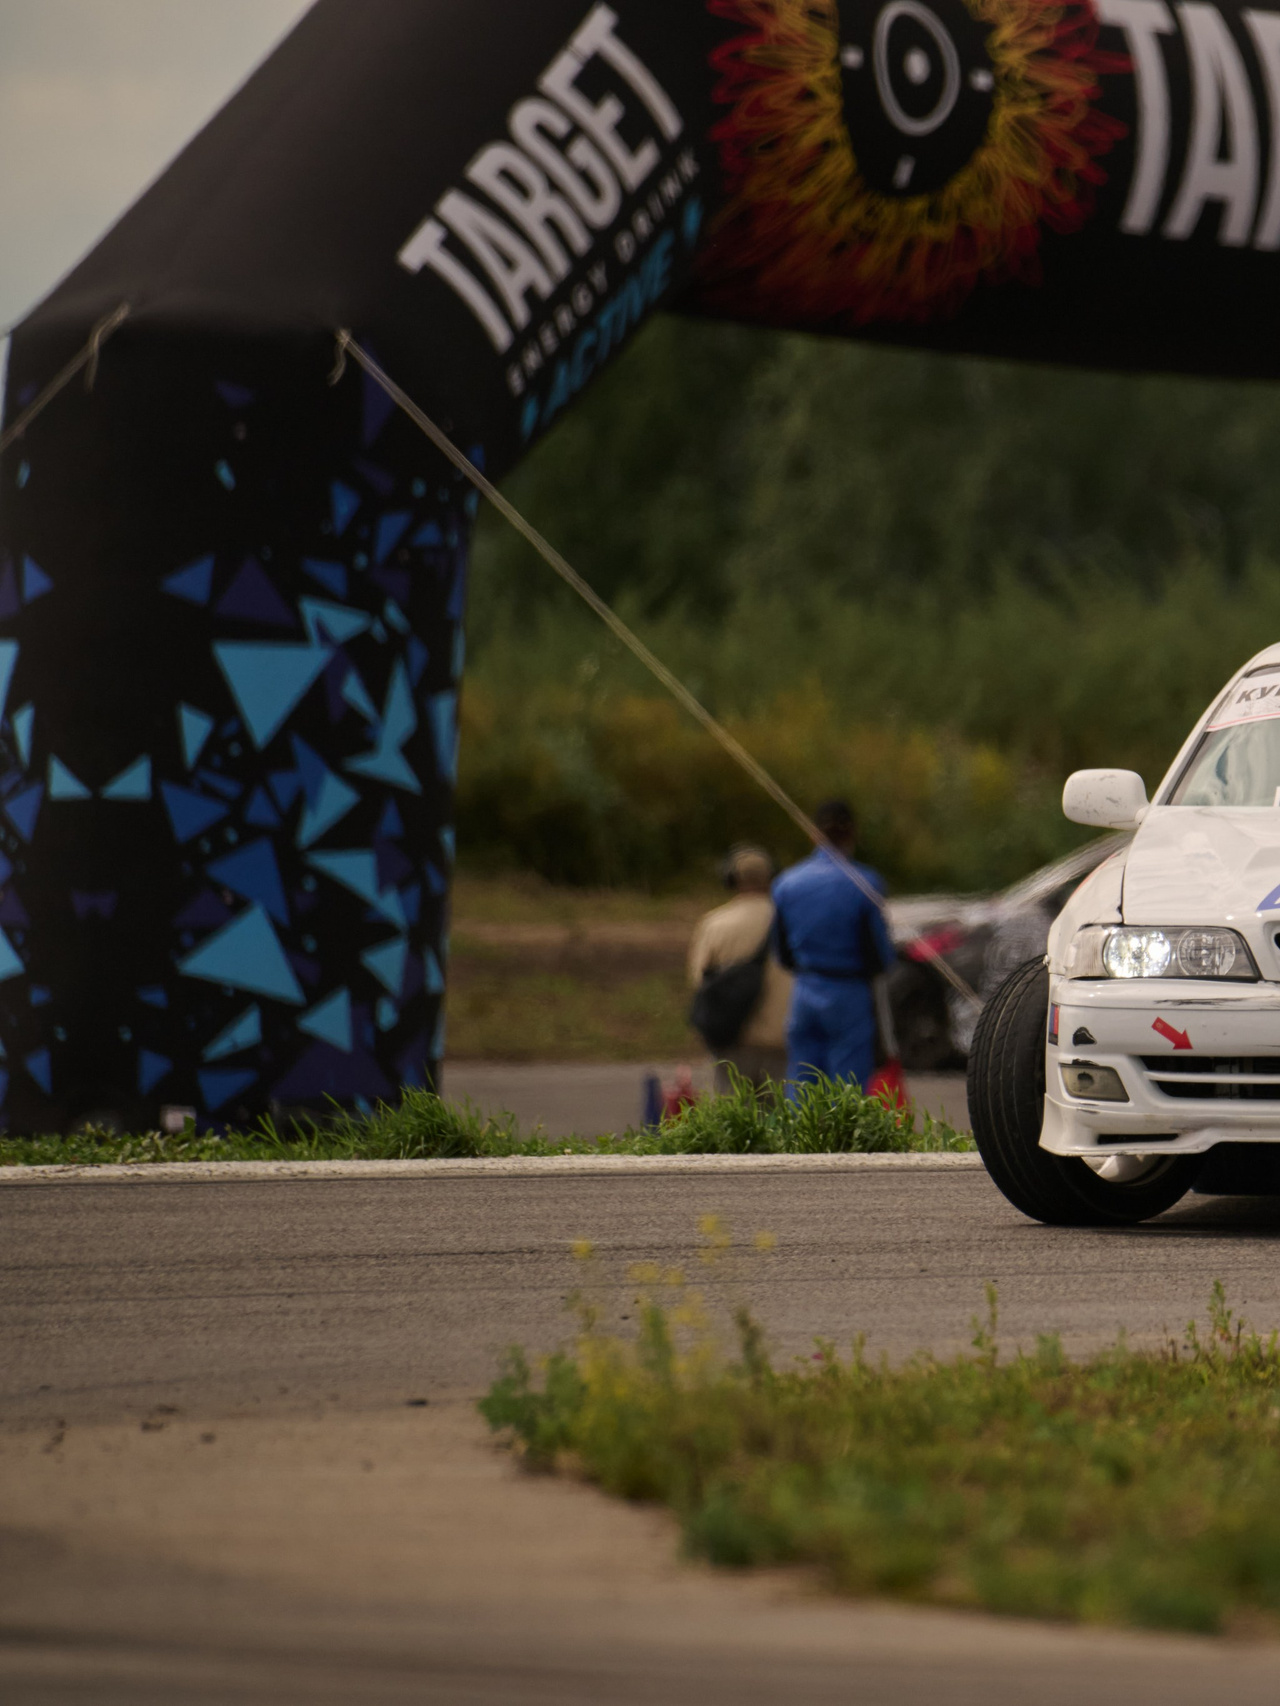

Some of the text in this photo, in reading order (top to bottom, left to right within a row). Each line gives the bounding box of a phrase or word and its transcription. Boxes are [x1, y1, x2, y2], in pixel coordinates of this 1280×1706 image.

[398, 2, 688, 356] TARGET
[506, 147, 701, 398] ENERGY DRINK
